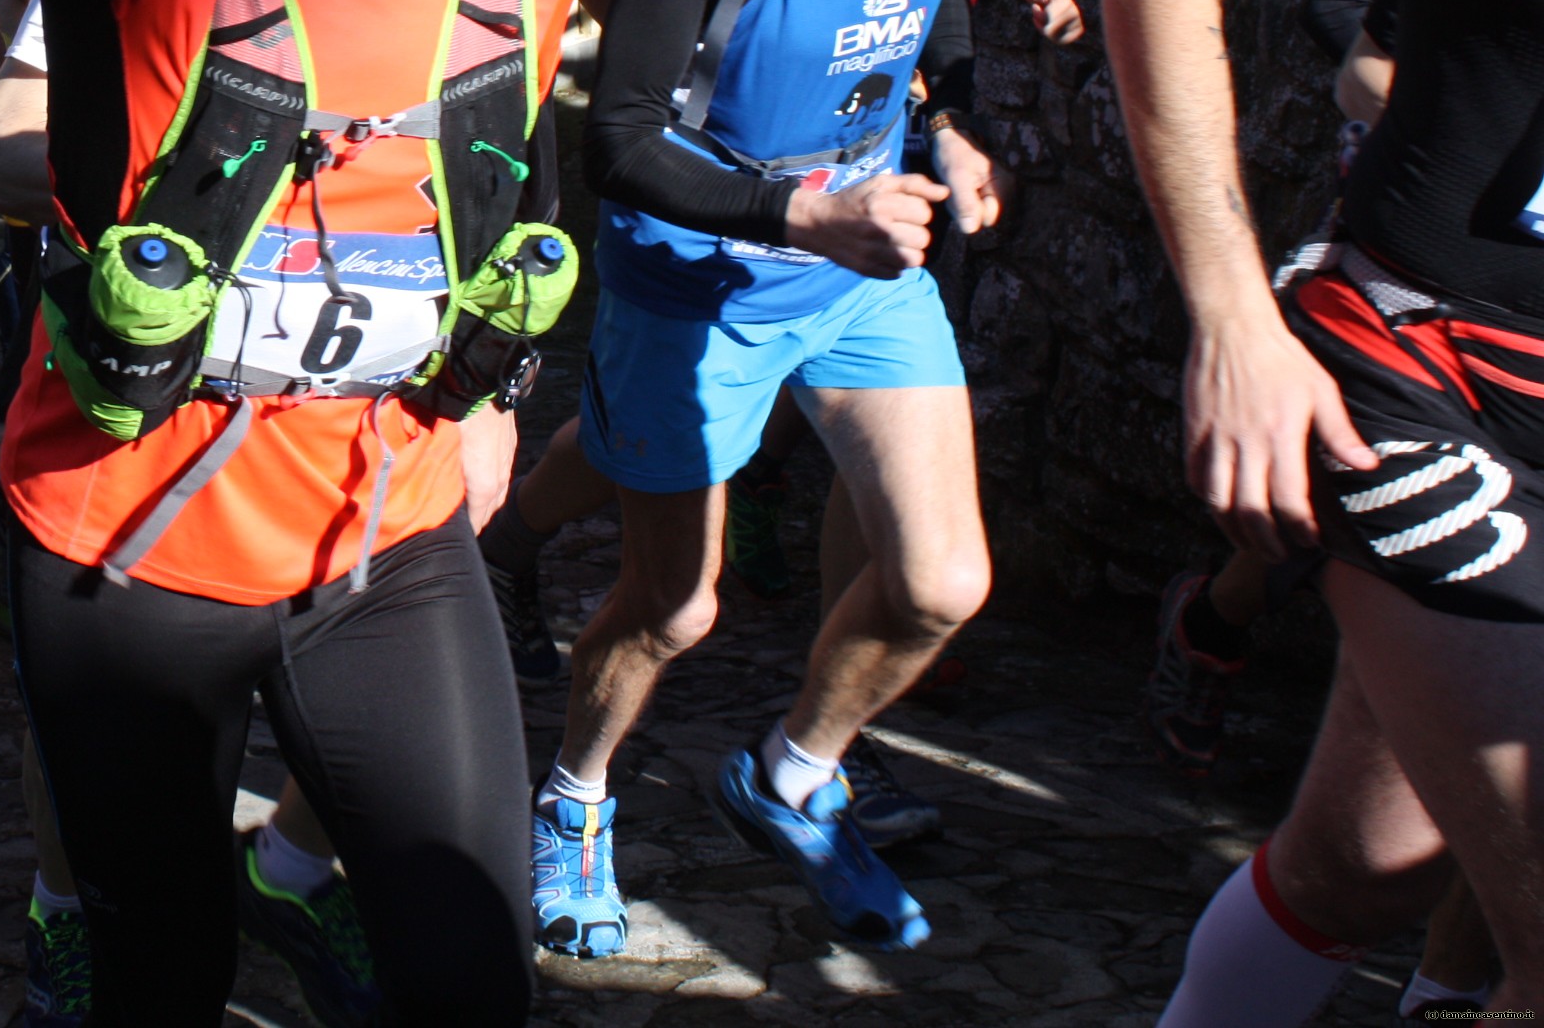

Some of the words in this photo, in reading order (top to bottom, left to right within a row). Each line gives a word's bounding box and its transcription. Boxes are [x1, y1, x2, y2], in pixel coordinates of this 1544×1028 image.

[833, 8, 926, 57] BMA
[229, 76, 284, 106] CAMP
[461, 65, 507, 94] CAMP
[300, 291, 373, 375] 6
